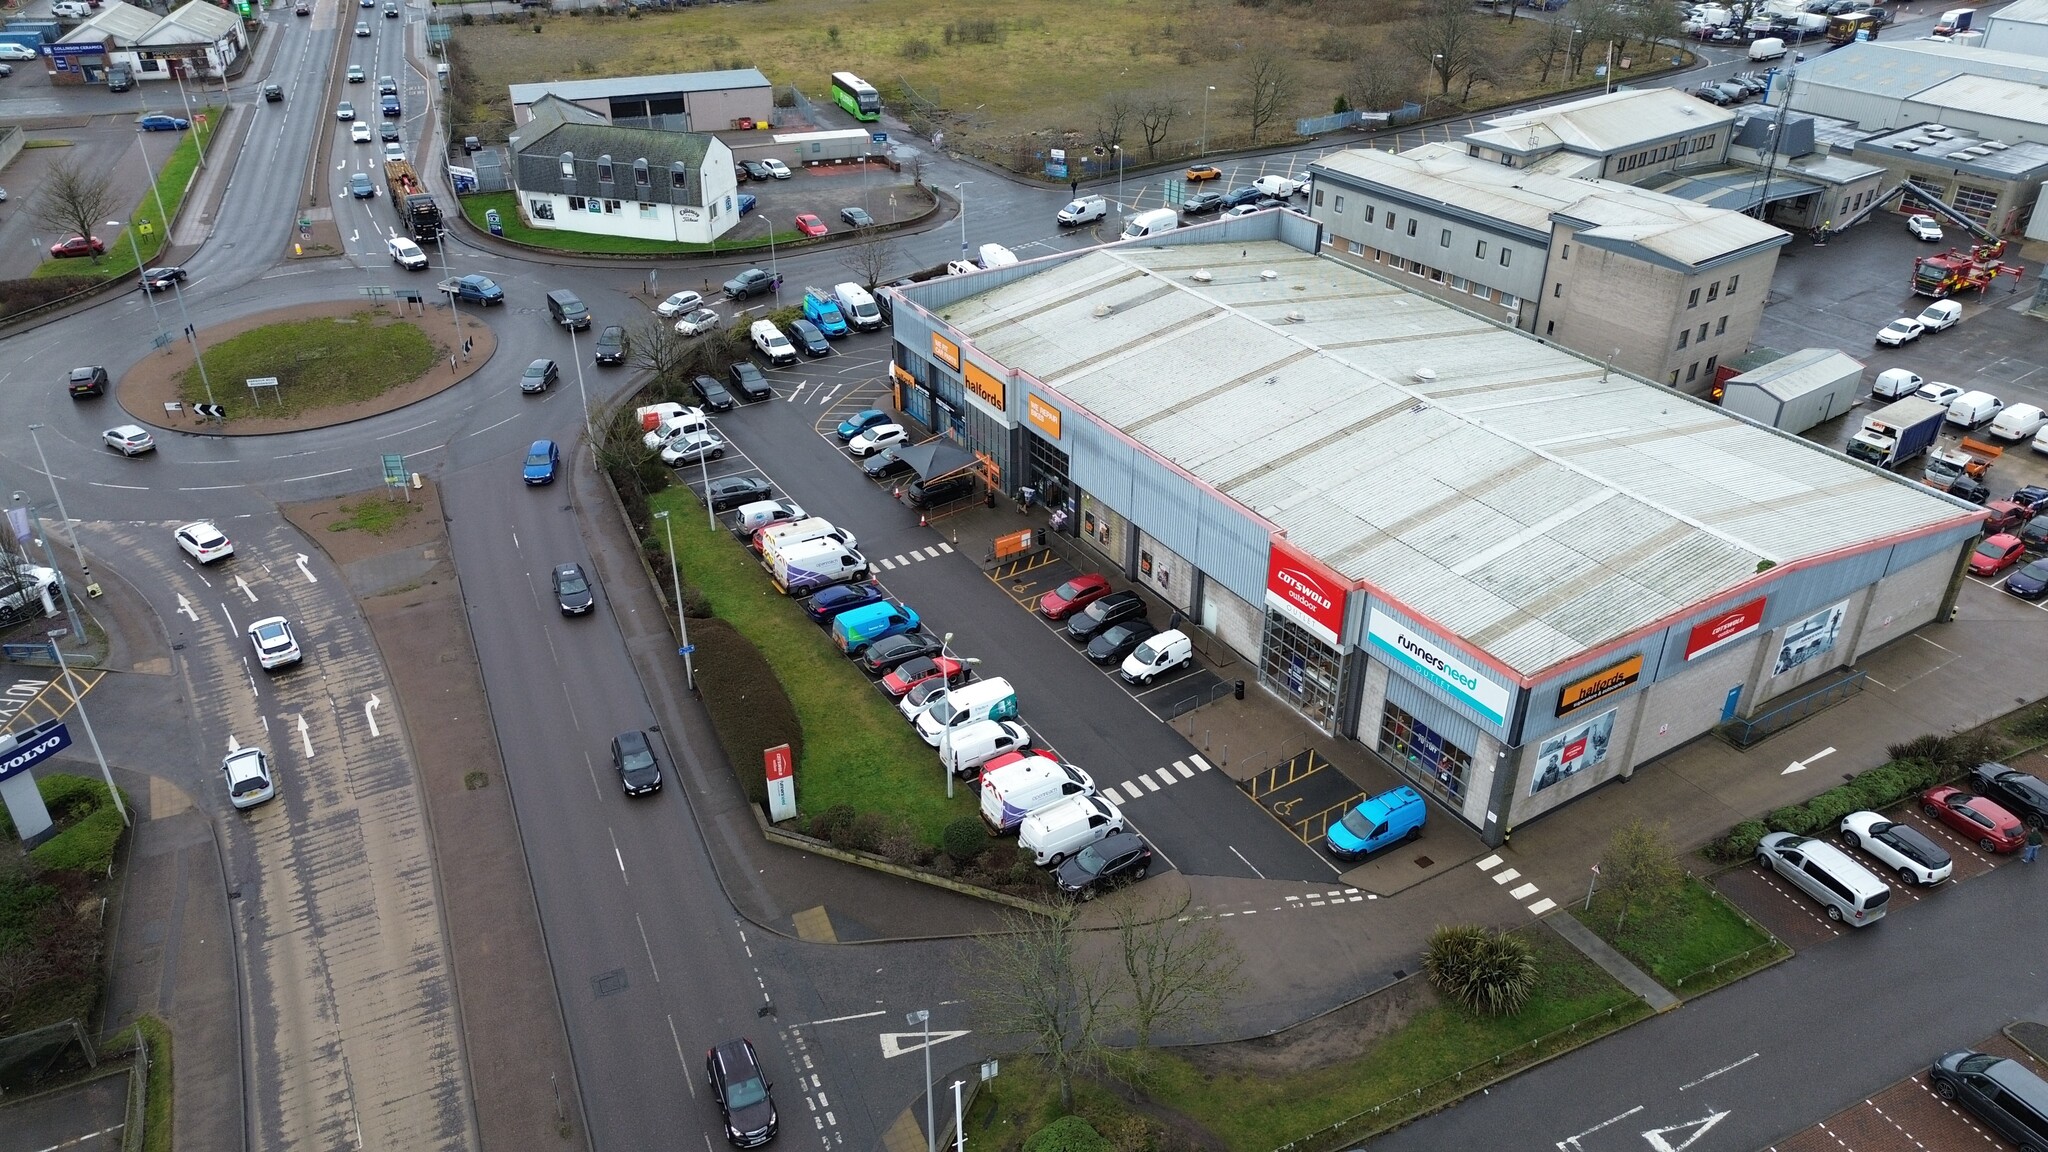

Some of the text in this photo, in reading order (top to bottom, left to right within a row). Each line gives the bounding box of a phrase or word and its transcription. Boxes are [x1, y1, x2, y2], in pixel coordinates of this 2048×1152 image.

[965, 375, 1002, 410] halfords
[1030, 401, 1058, 424] WE REPAIR
[815, 558, 838, 567] openreach
[1277, 570, 1332, 610] COTSWOLD
[1288, 590, 1317, 612] outdoor
[1286, 604, 1316, 627] OUTLET
[1712, 615, 1746, 635] COTSWOLD
[1717, 627, 1736, 638] outdoor
[1397, 634, 1477, 691] runnersneed
[6, 679, 49, 697] NO
[1415, 664, 1451, 691] OUTLET
[1579, 672, 1624, 700] halfords
[0, 736, 61, 774] VOLVO
[1032, 787, 1058, 801] openreach
